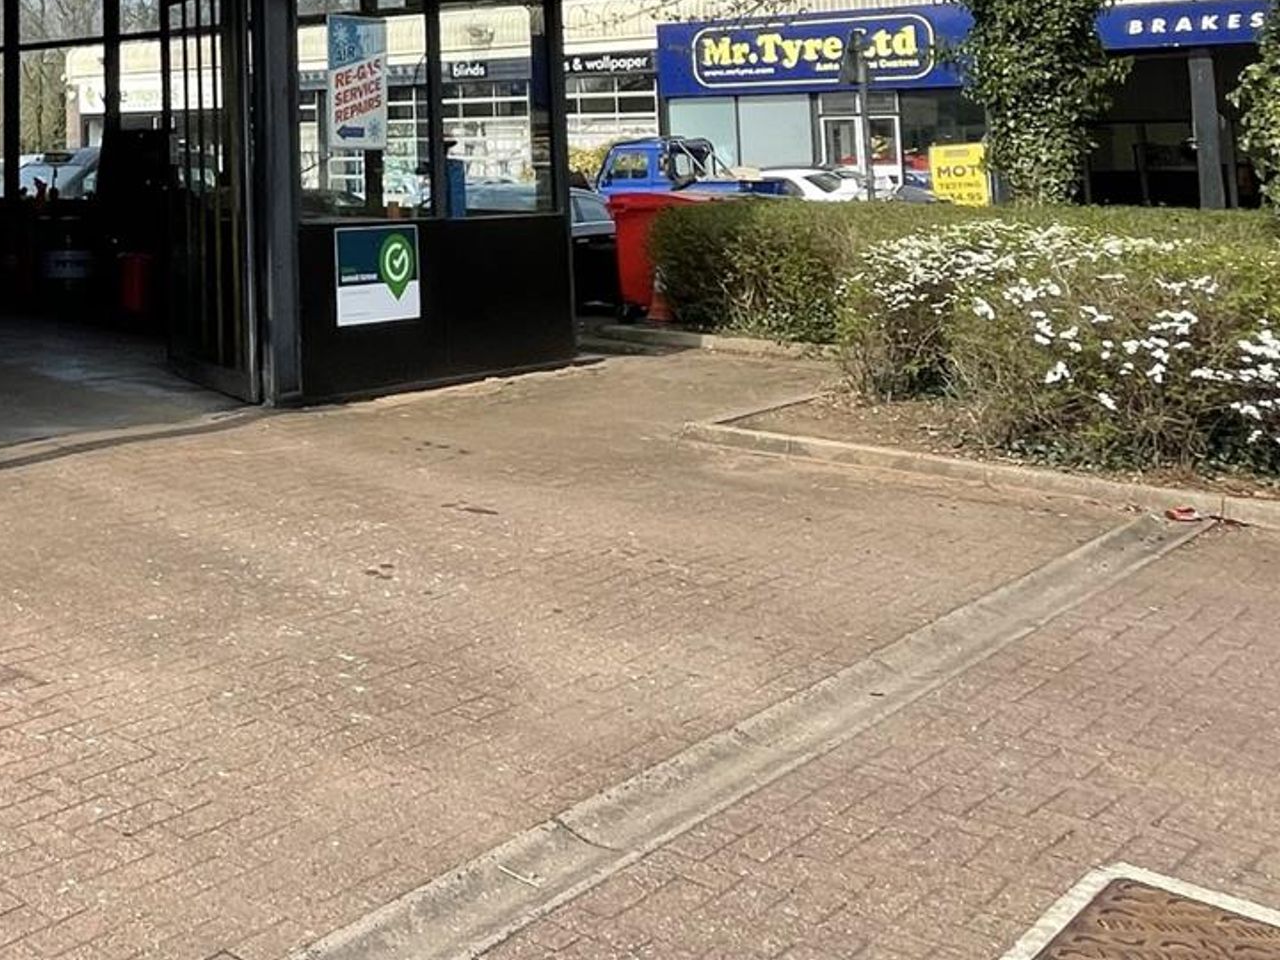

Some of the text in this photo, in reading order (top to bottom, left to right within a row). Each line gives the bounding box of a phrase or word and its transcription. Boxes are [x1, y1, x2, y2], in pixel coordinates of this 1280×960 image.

[1128, 11, 1266, 35] BRAKES
[334, 58, 381, 89] RE-GAS
[453, 62, 485, 77] blinds
[584, 54, 648, 72] wallpaper
[334, 77, 381, 106] SERVICE
[334, 94, 382, 123] REPAIRS
[937, 165, 980, 178] MOT
